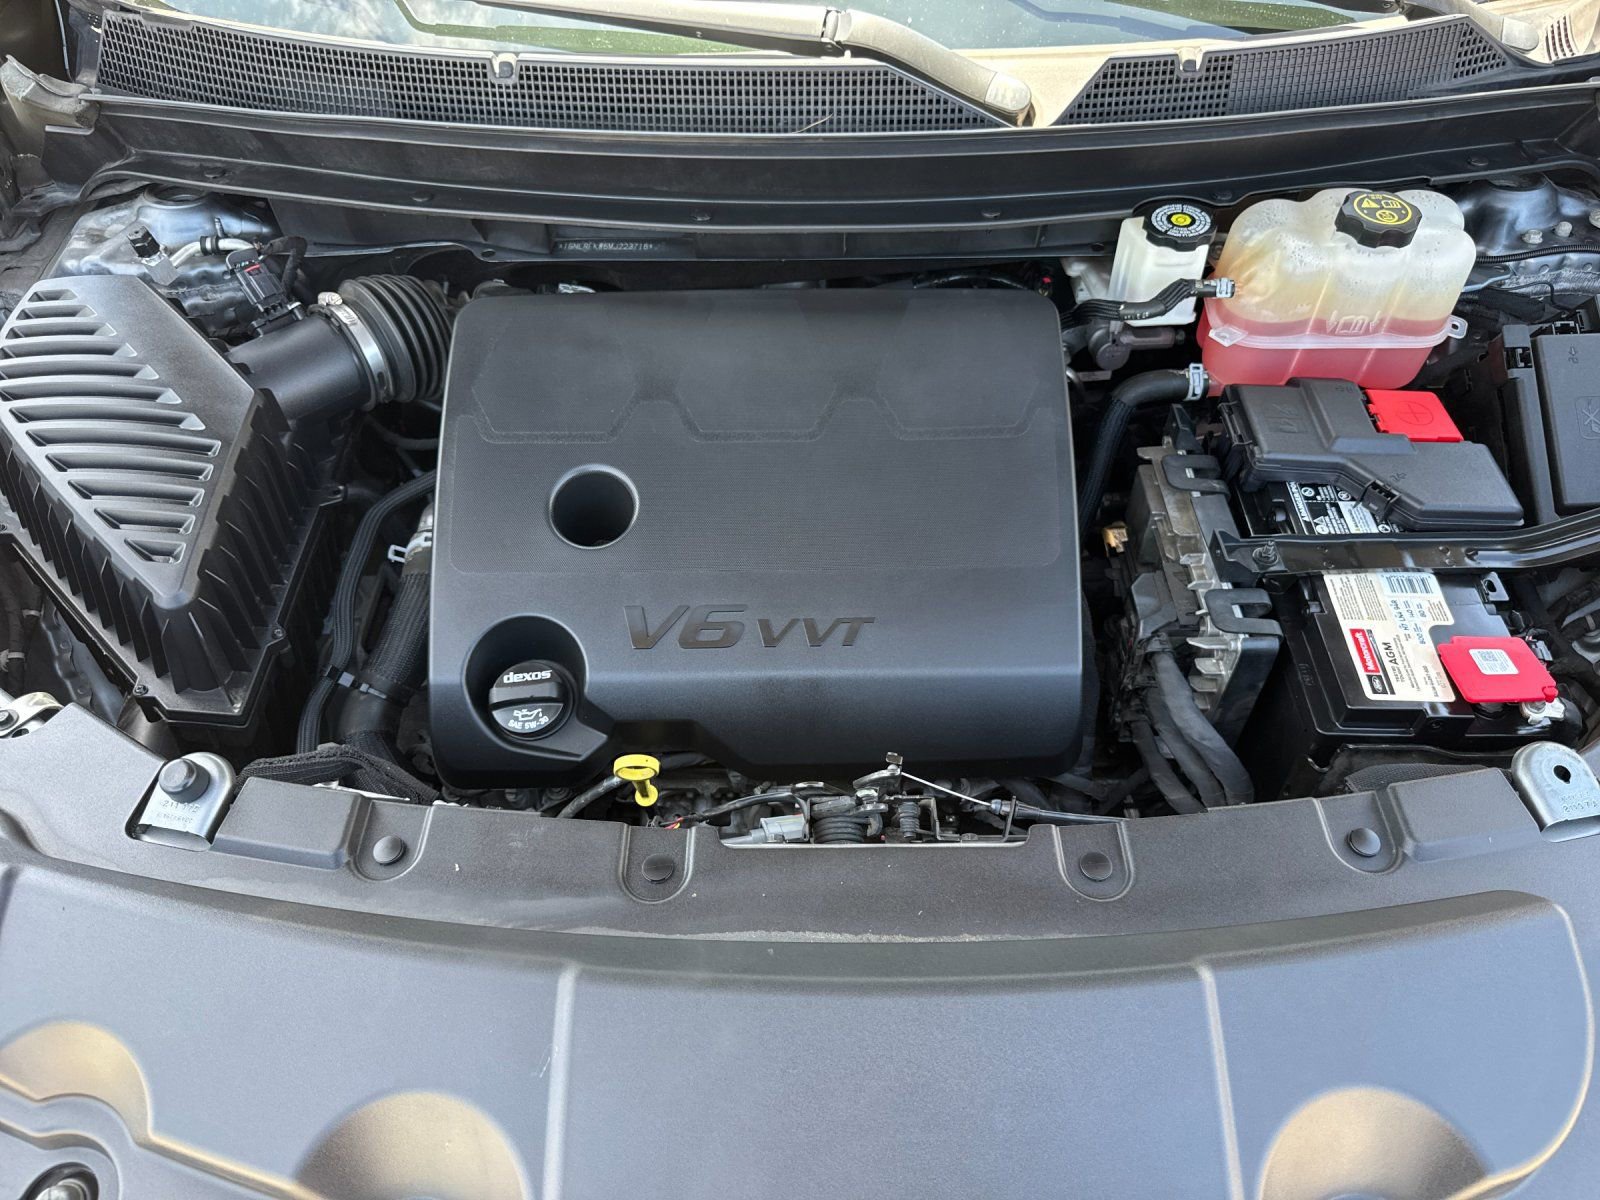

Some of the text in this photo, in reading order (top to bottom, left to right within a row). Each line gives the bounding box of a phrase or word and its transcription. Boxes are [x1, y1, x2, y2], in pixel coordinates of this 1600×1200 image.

[624, 604, 876, 649] V6 VVT
[1355, 631, 1376, 671] Motorcraft
[1381, 641, 1399, 665] AGM
[503, 670, 553, 683] dexos
[508, 716, 550, 729] SAE 5W-30
